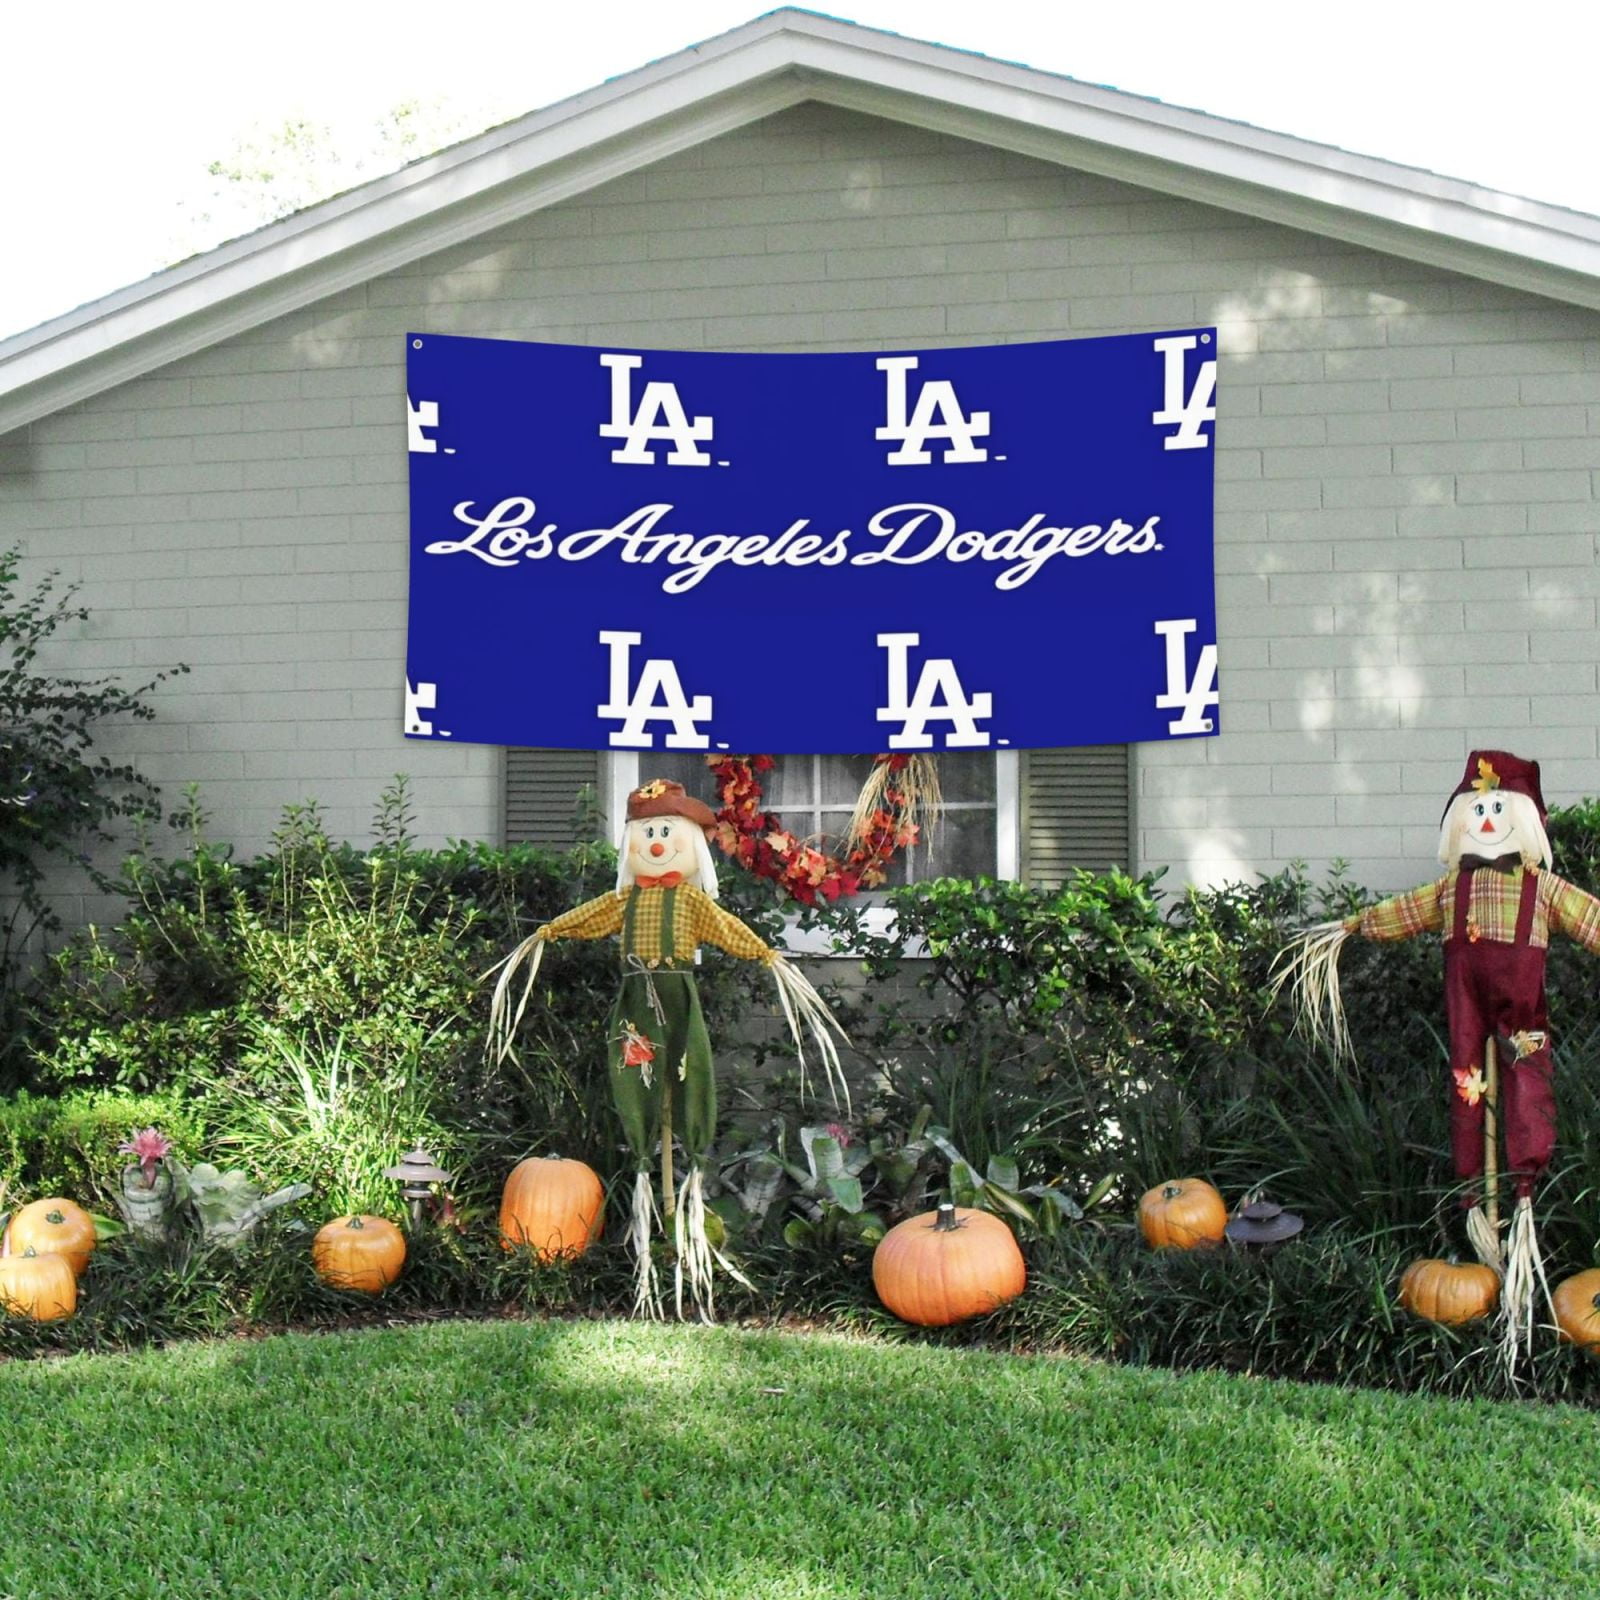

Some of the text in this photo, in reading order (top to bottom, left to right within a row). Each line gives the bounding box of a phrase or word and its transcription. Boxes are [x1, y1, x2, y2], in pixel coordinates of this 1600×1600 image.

[599, 353, 713, 466] LA
[875, 356, 990, 466] LA
[424, 496, 558, 567] Los
[557, 503, 852, 594] Angeles
[597, 630, 713, 749] LA
[876, 632, 993, 749] LA
